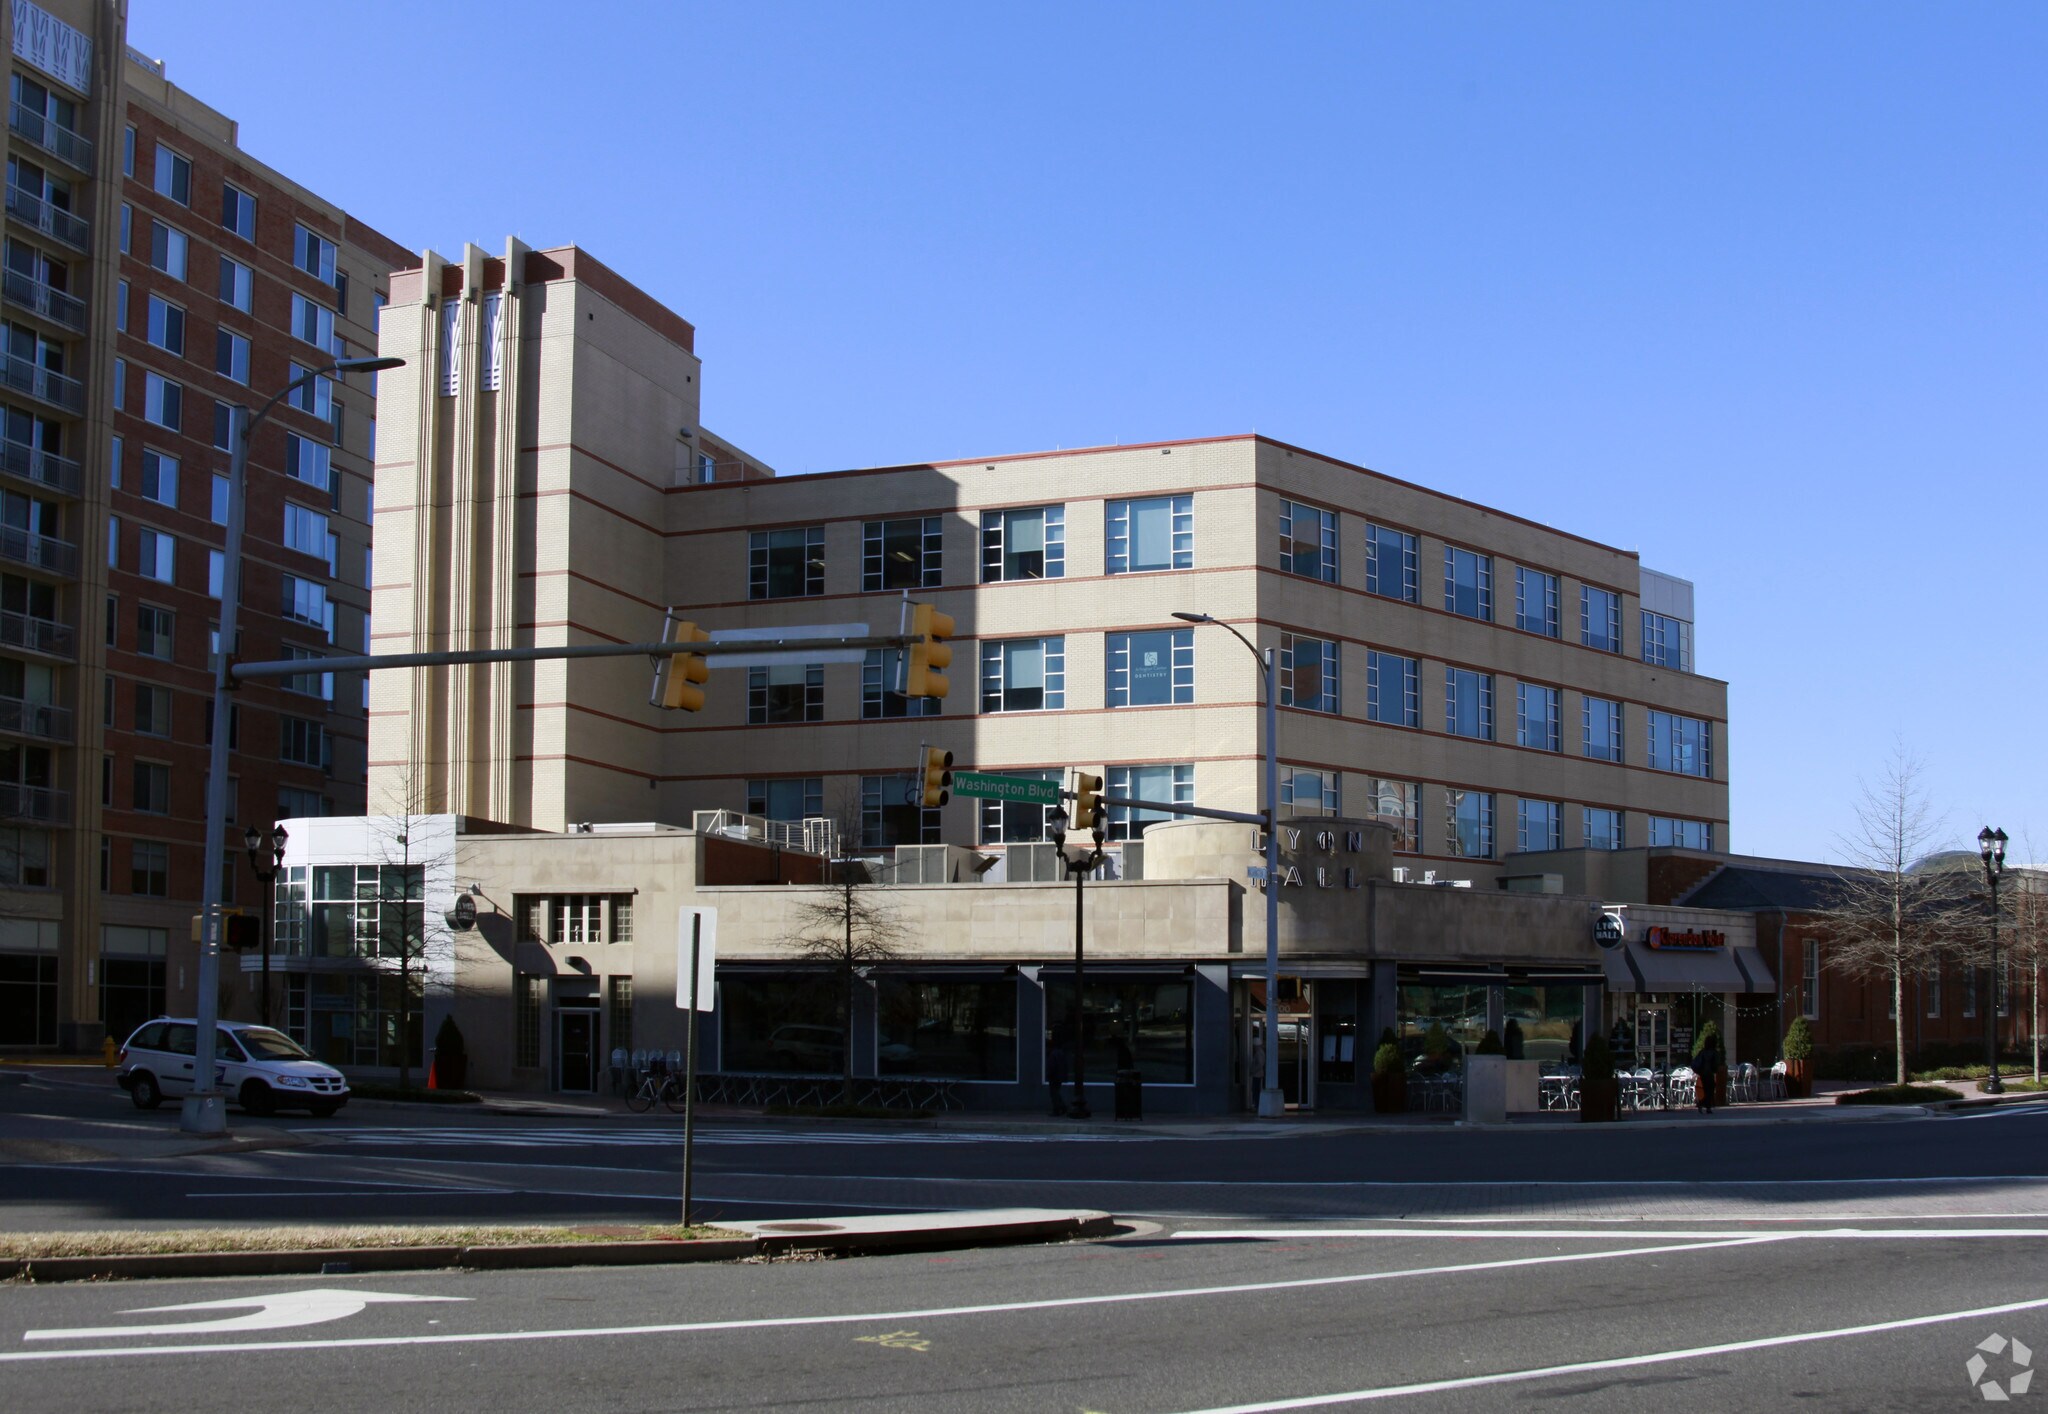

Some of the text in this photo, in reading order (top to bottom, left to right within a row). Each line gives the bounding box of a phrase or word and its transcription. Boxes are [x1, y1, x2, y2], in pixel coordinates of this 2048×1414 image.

[956, 777, 1056, 798] Washington Blvd.
[1251, 829, 1362, 852] LYON
[1596, 922, 1620, 931] LYON
[1596, 931, 1619, 939] HALL
